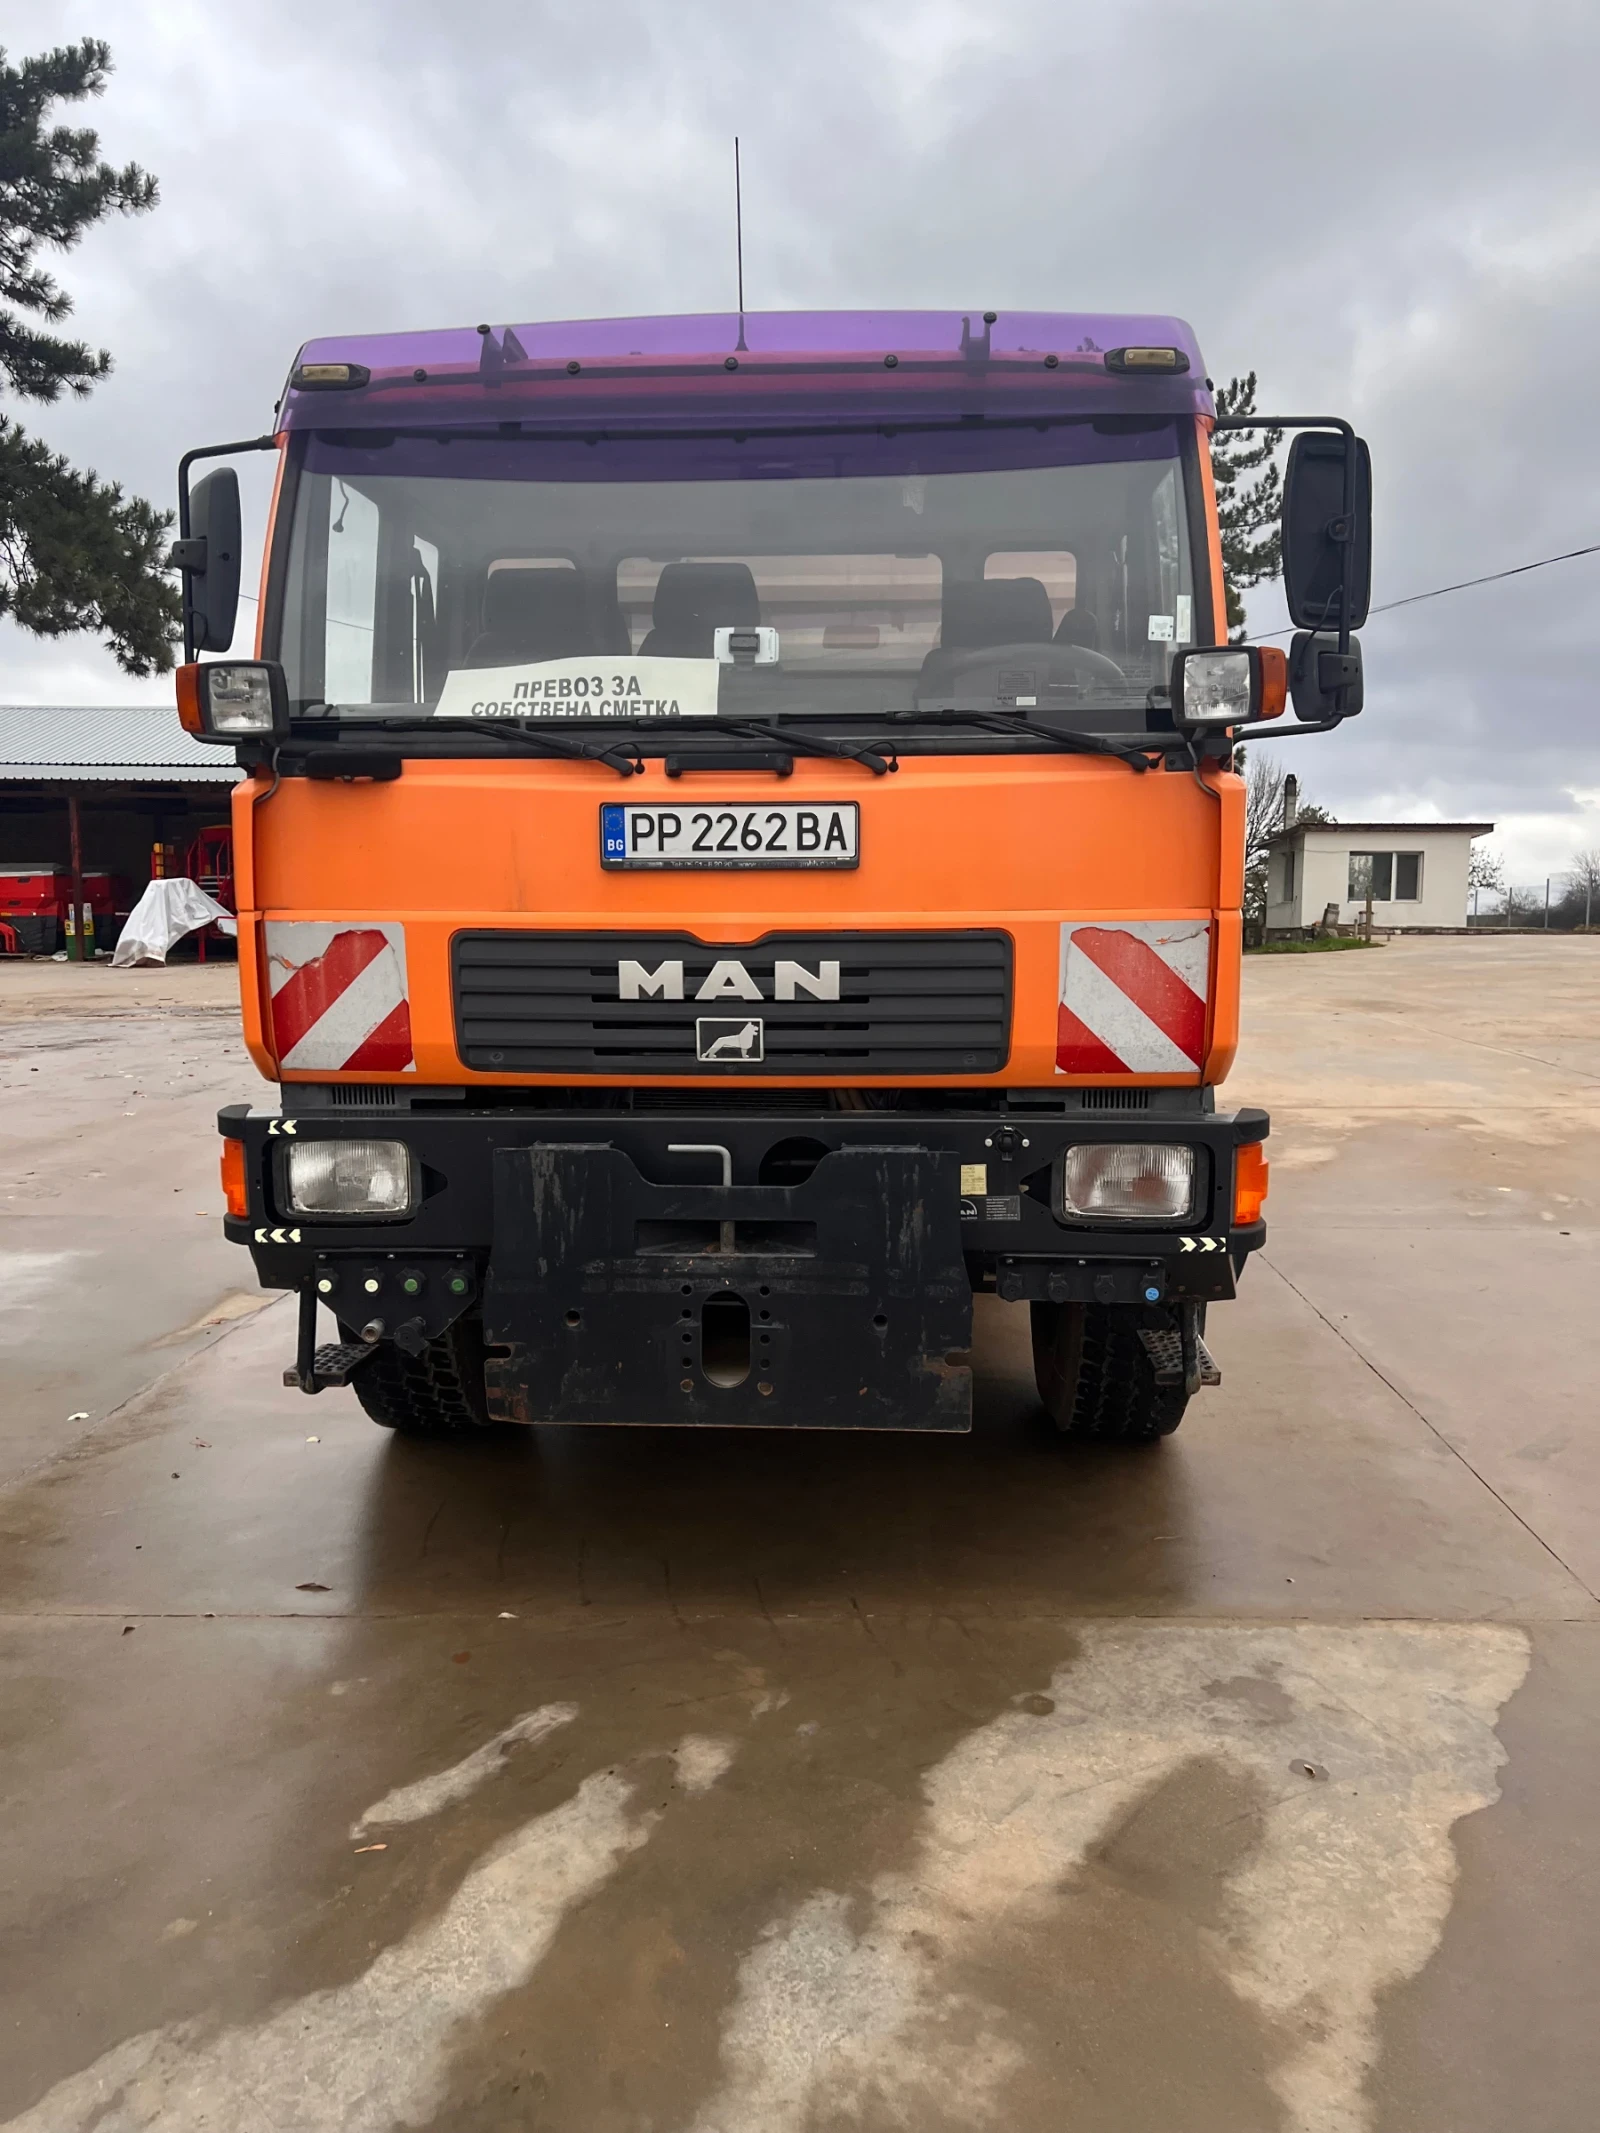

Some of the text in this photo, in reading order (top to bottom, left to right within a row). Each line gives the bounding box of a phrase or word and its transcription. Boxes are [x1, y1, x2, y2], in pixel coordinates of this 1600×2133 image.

[513, 675, 642, 699] ПРЕВОЗ ЗА
[471, 700, 681, 716] СОБСТВЕНА СМЕТКА
[631, 812, 847, 851] PP 2262 BA
[607, 839, 624, 851] BG
[618, 960, 840, 1000] MAN
